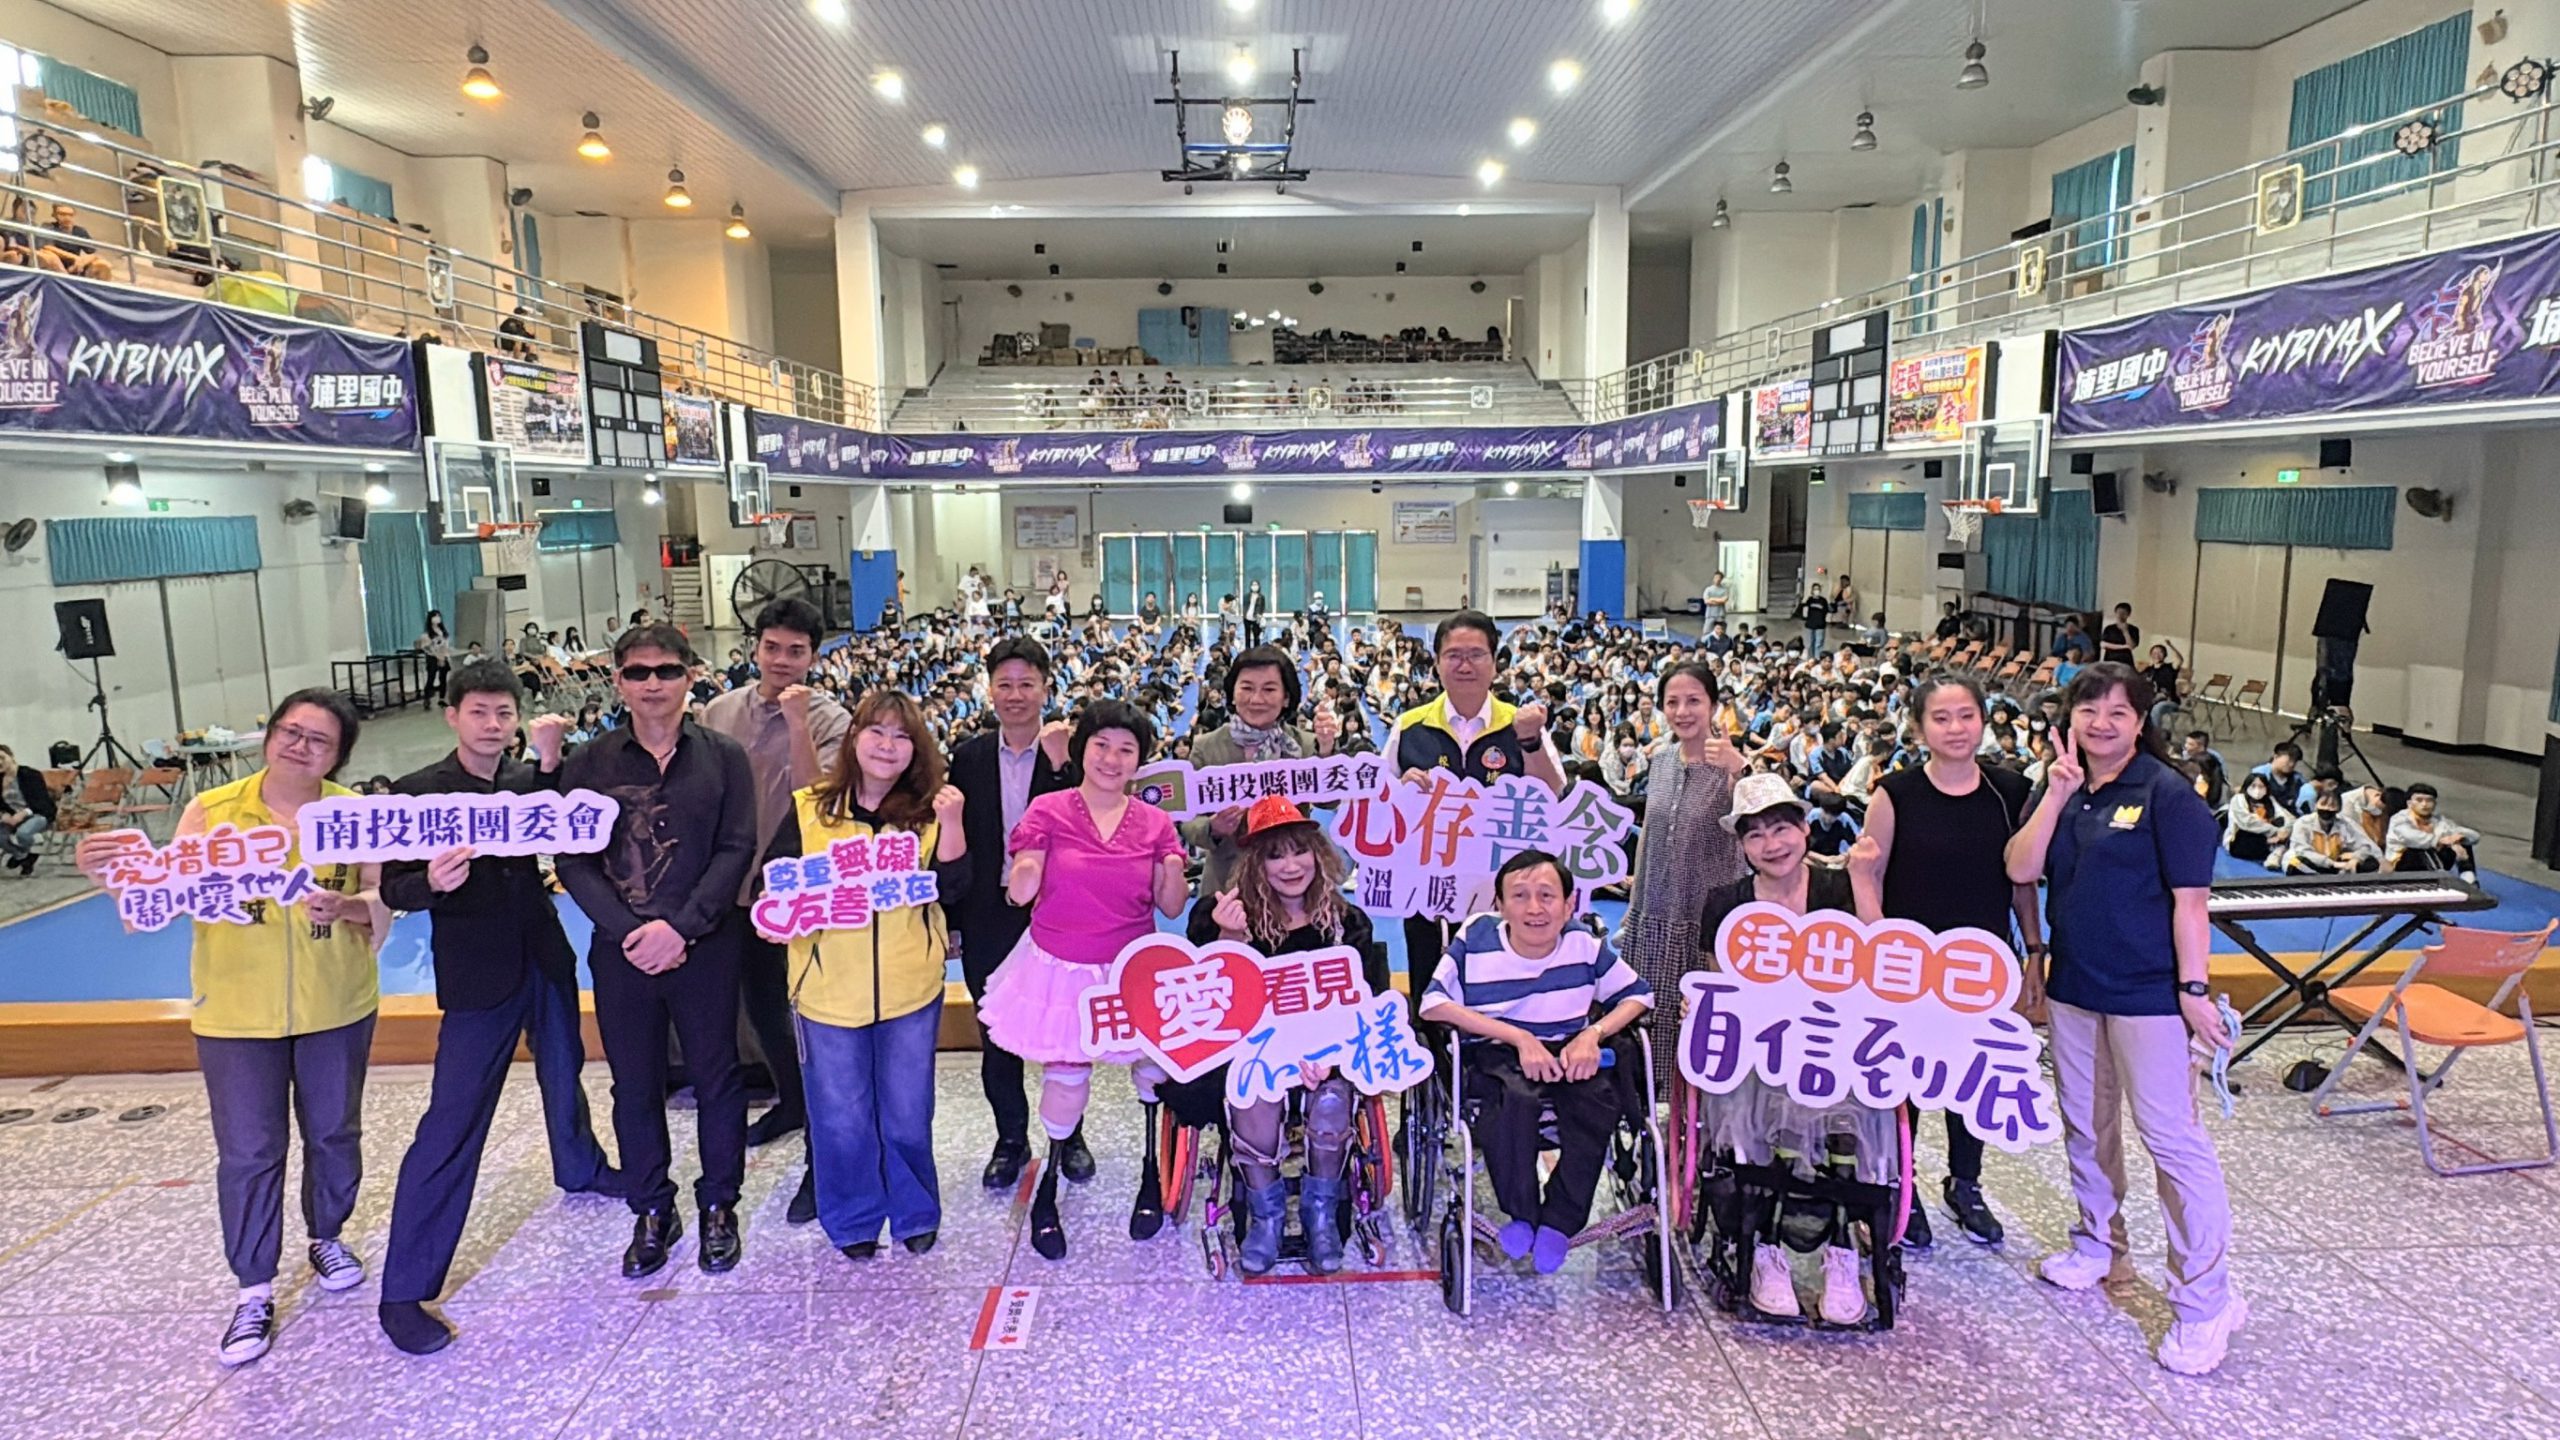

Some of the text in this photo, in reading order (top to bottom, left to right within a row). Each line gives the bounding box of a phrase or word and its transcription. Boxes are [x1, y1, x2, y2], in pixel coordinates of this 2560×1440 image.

[32, 358, 49, 379] IN
[2407, 329, 2491, 366] BELIEVE IN
[2416, 349, 2499, 384] YOURSELF
[310, 374, 403, 409] 埔里國中
[2070, 348, 2168, 403] 埔里國中
[2174, 369, 2214, 392] BELIEVE
[2180, 382, 2232, 408] YOURSELF
[1197, 762, 1380, 804] 南投縣團委會
[312, 801, 605, 852] 南投縣團委會
[109, 827, 286, 885] 愛惜自己
[124, 864, 314, 927] 關懷他人
[756, 874, 934, 935] 友善常在
[1737, 919, 1996, 1007] 活出自己
[1237, 1001, 1425, 1098] 不一樣
[1690, 982, 2049, 1142] 自信到底
